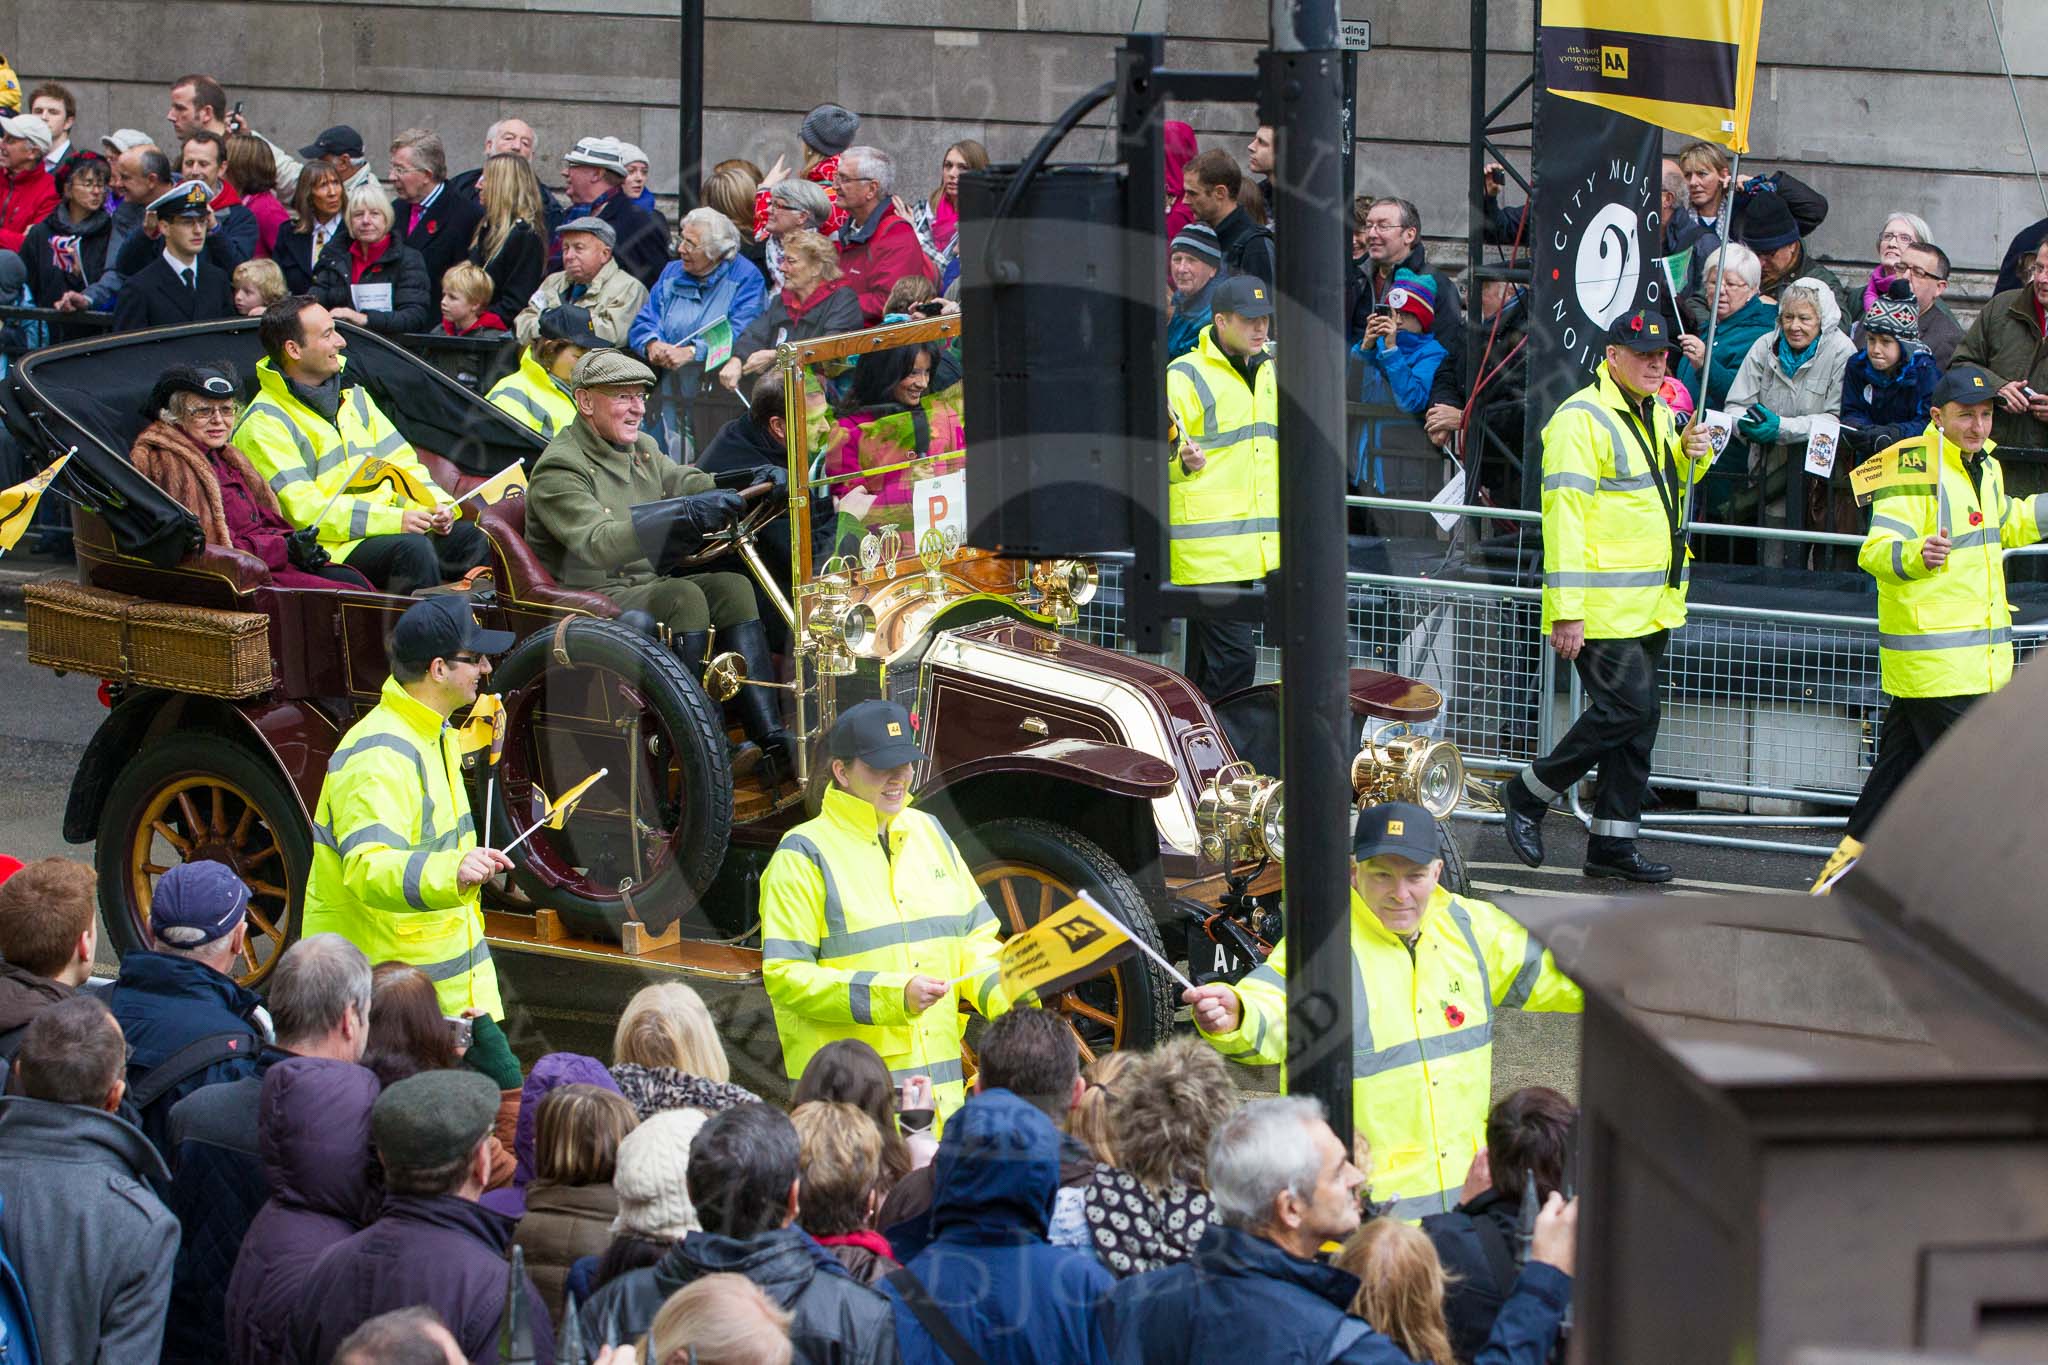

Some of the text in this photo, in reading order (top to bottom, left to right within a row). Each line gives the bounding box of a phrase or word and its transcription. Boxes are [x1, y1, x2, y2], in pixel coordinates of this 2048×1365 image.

[1345, 36, 1366, 46] time
[1554, 171, 1596, 251] CITY
[1608, 158, 1660, 232] MUSIC
[928, 495, 948, 529] P
